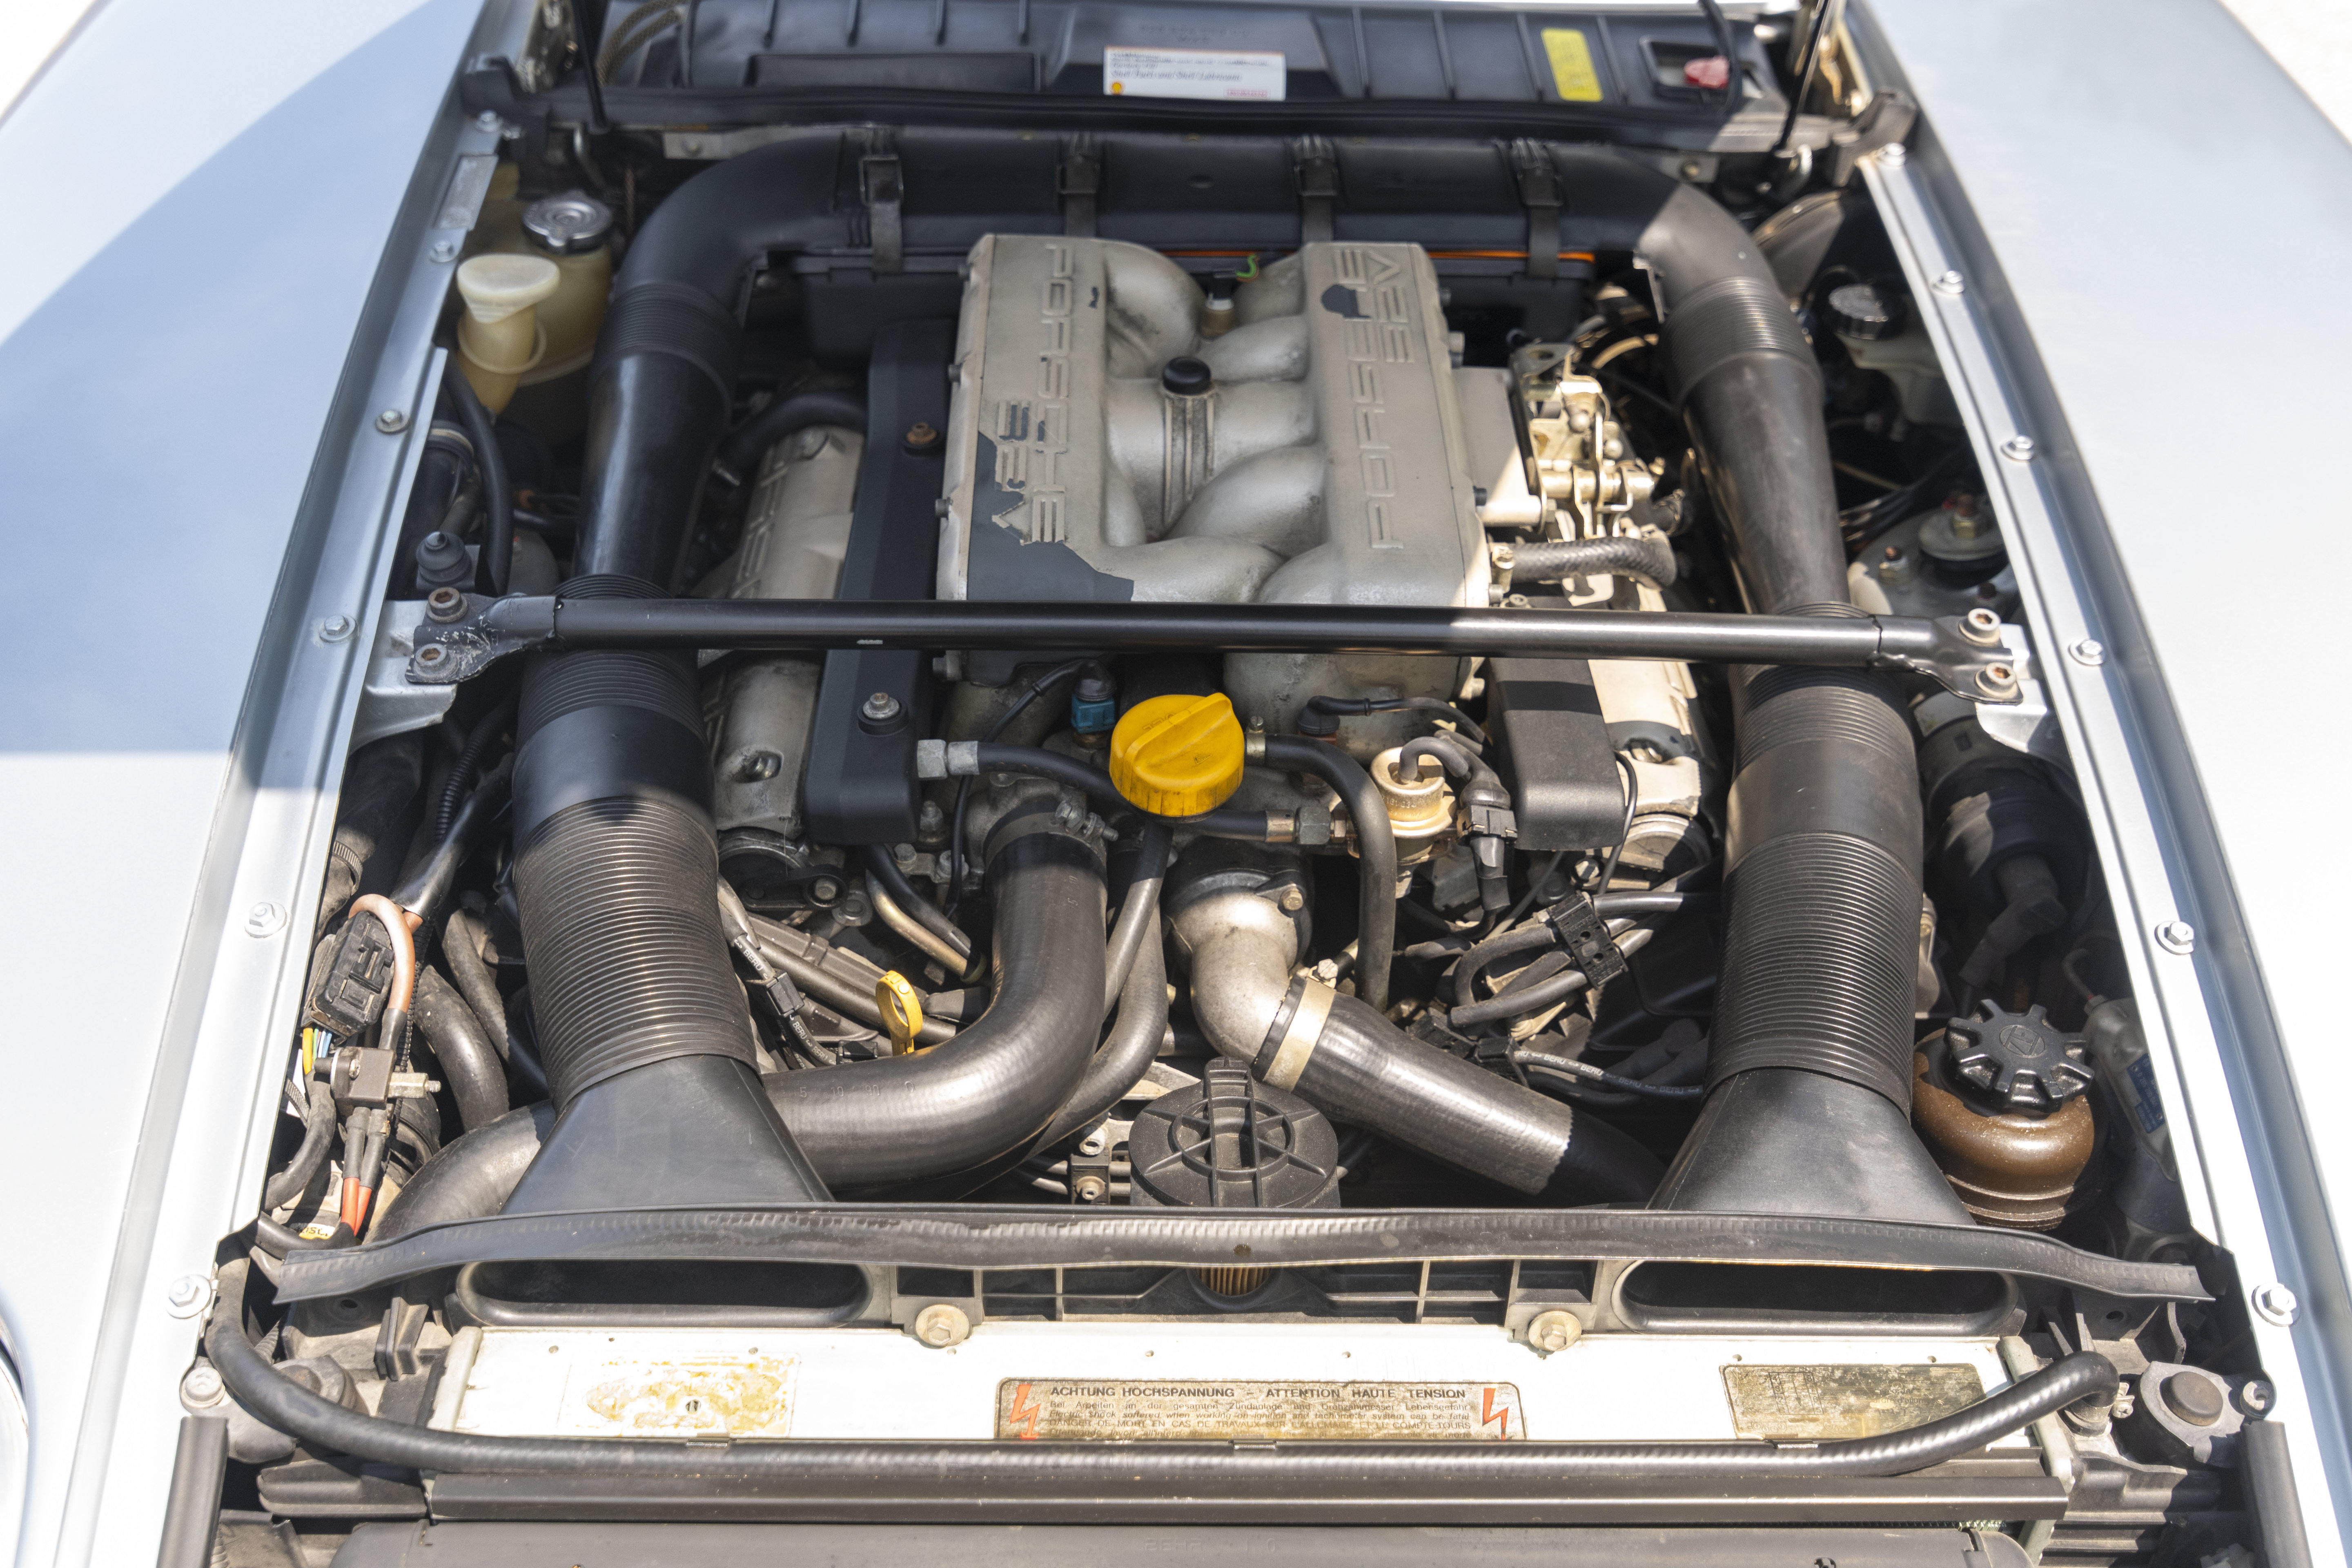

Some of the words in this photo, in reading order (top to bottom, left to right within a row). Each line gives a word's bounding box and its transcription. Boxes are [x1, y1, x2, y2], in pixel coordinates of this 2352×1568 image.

[1368, 251, 1412, 363] 32V
[1031, 244, 1074, 543] PORSCHE
[1335, 249, 1404, 550] PORSCHE
[744, 949, 763, 971] BERU
[793, 1021, 807, 1039] BERU
[812, 1046, 828, 1061] BERU
[2005, 1025, 2039, 1055] ZF
[1544, 1054, 1566, 1065] BERU
[1580, 1064, 1604, 1076] BERU
[1618, 1076, 1642, 1088] BERU
[1659, 1085, 1684, 1094] BERU
[800, 1087, 808, 1098] 5
[1051, 1387, 1115, 1396] ACHTUNG
[1123, 1387, 1235, 1397] HOCHSPANNUNG
[1266, 1388, 1340, 1398] ATTENTION
[1352, 1388, 1396, 1398] HAUTE
[1409, 1389, 1466, 1398] TENSION
[1229, 1403, 1283, 1411] Zündanlage
[1405, 1403, 1468, 1411] Lebensgefahr
[1196, 1412, 1232, 1420] working
[1254, 1412, 1286, 1420] ignition
